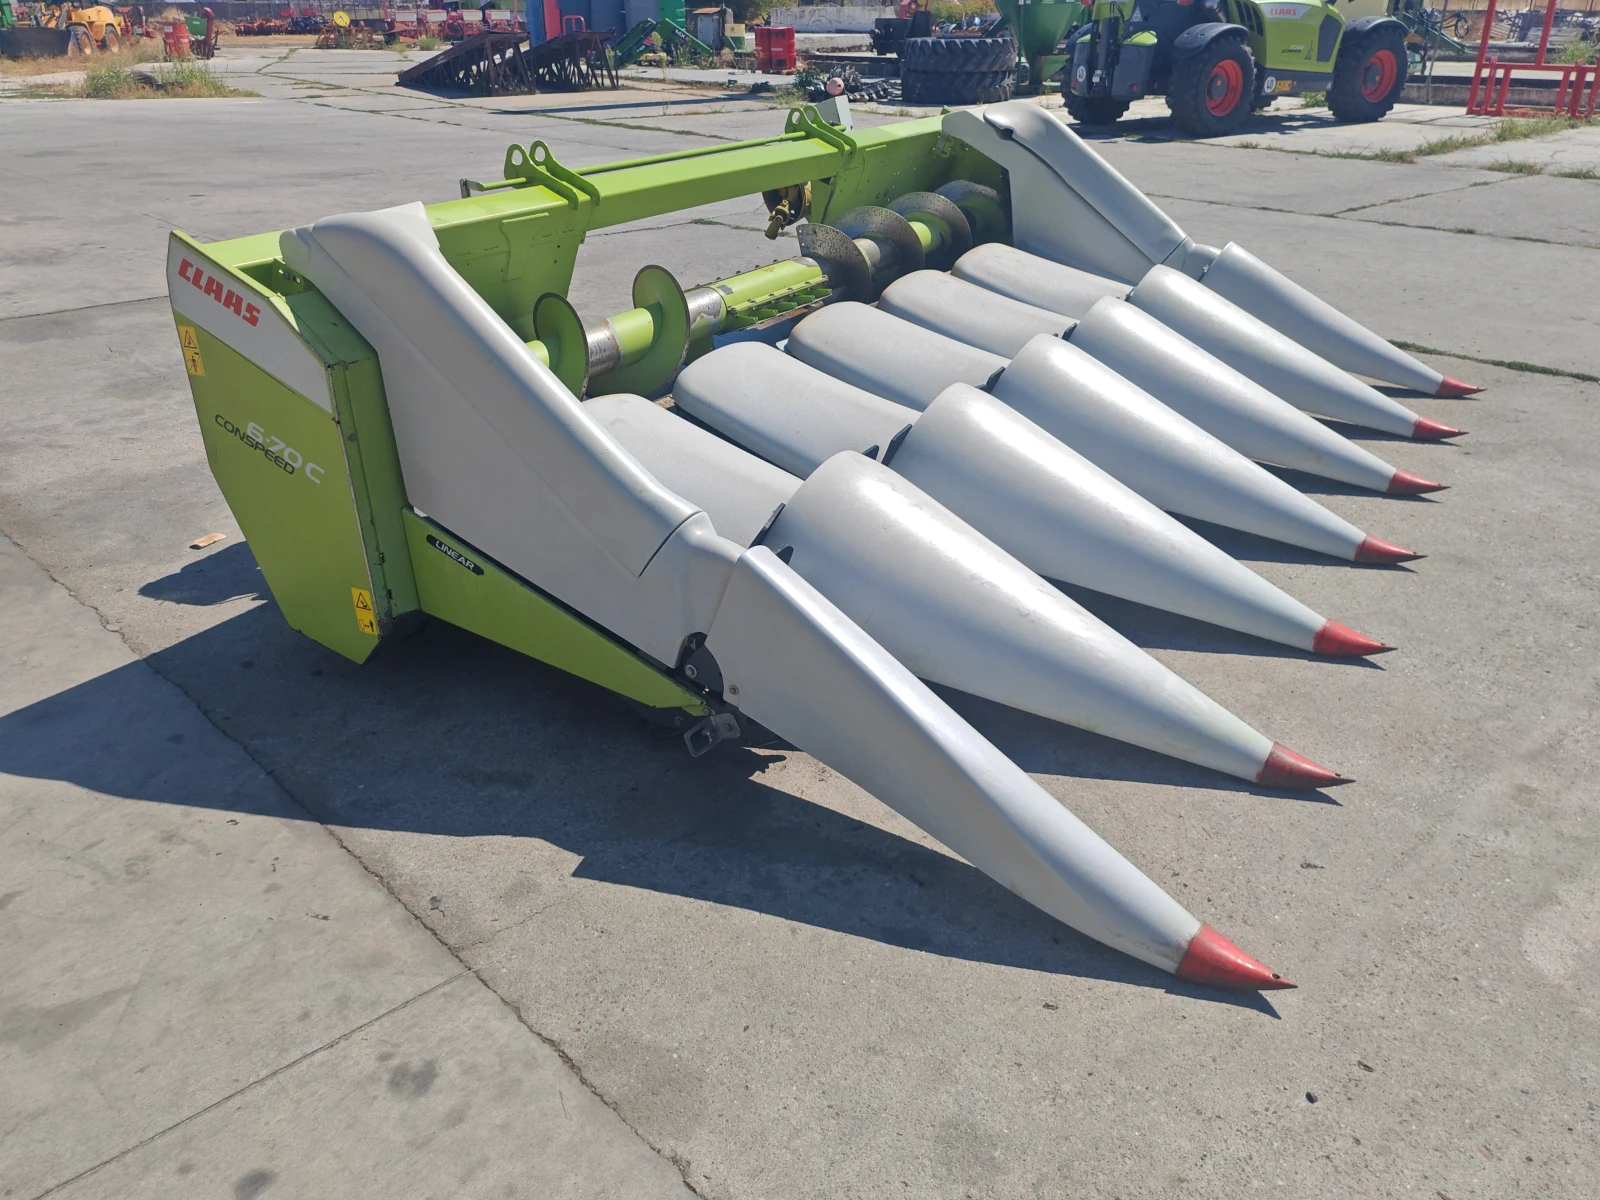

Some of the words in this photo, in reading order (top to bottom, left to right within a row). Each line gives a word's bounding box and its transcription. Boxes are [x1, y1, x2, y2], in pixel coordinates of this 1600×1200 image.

[1269, 8, 1297, 16] CLAAS
[178, 258, 261, 327] CLAAS
[214, 413, 296, 475] CONSPEED
[305, 462, 325, 484] C
[435, 540, 475, 571] LINEAR
